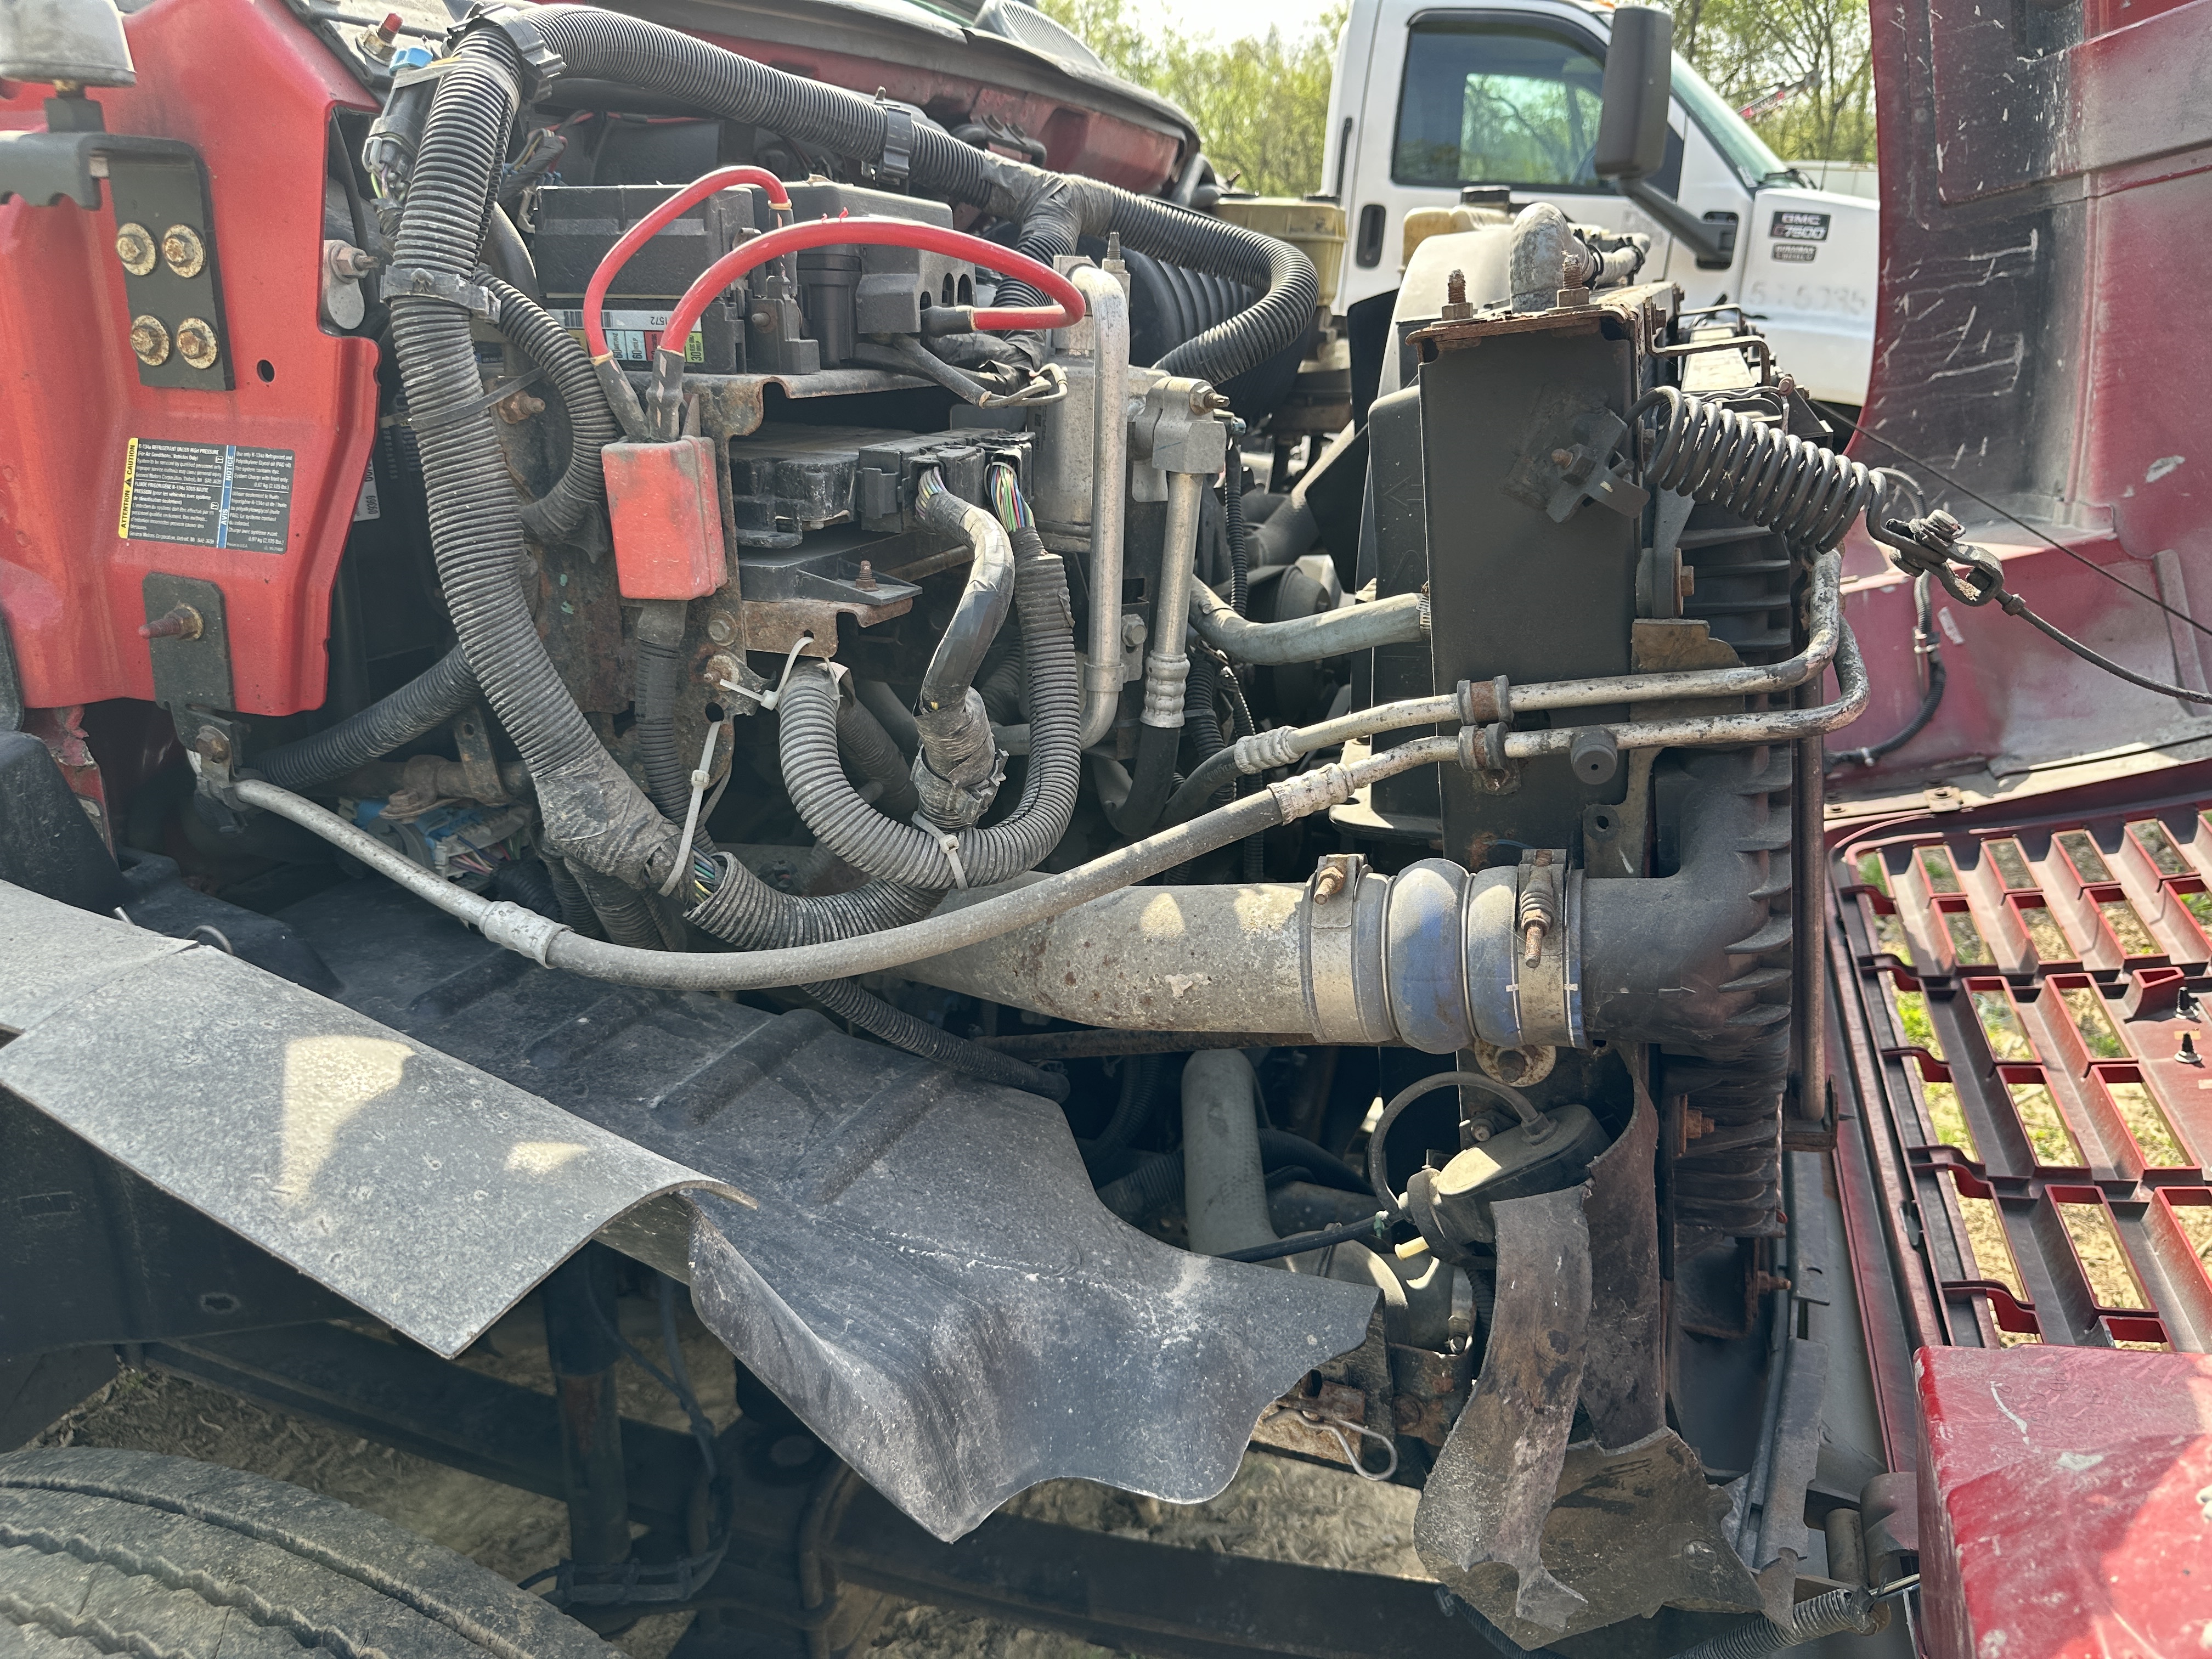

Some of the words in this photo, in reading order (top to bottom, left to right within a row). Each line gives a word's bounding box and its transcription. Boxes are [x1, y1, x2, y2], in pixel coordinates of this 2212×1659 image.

[1781, 212, 1822, 226] GMC
[1773, 223, 1827, 240] C7500
[632, 350, 642, 359] 60
[691, 352, 702, 361] 30
[127, 444, 136, 475] CAUTION
[225, 455, 234, 481] NOTICE
[121, 490, 130, 528] ATTENTION
[366, 495, 379, 515] 09369
[221, 509, 229, 526] AVIS
